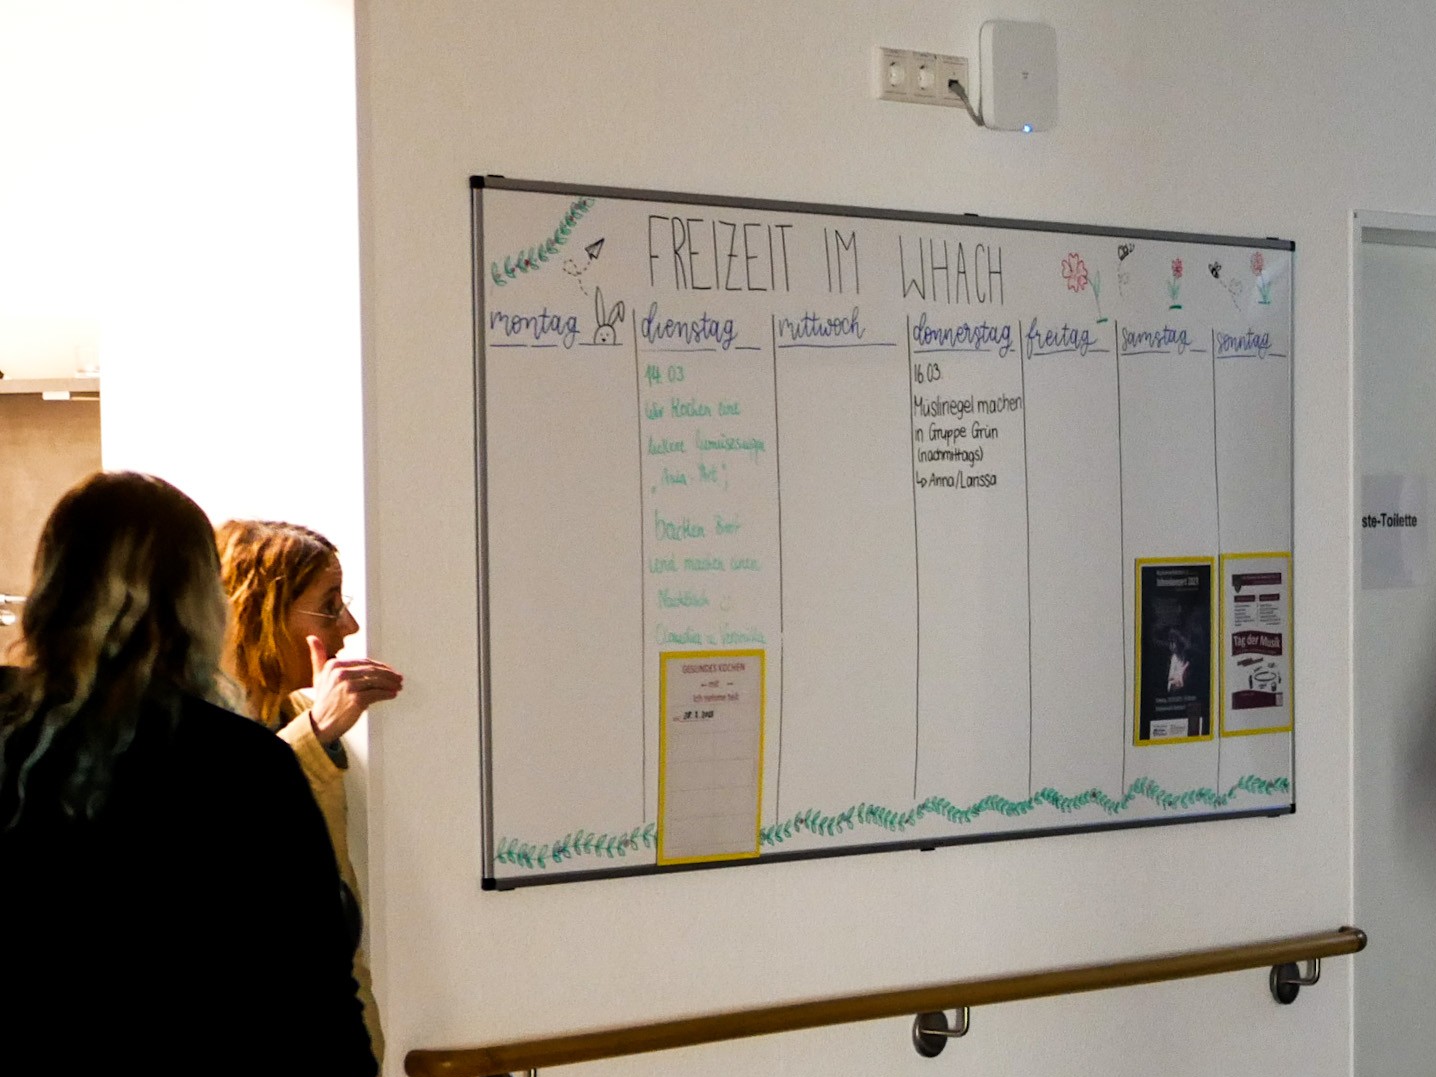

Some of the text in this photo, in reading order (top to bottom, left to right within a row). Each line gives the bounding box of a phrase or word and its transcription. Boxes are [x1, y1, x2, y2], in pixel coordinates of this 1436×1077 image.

[648, 215, 1004, 306] FREIZEIT IM WHACH
[489, 307, 580, 350] montag
[641, 301, 738, 350] dienstag
[913, 312, 1014, 359] donnerstag
[1026, 318, 1097, 359] freitag
[1121, 324, 1192, 355] samstag
[1217, 328, 1273, 359] sonntag
[977, 393, 1023, 415] machen
[928, 422, 967, 447] Gruppe
[971, 421, 998, 439] Grün
[1361, 512, 1418, 528] ste-Toilette
[1233, 635, 1246, 648] Tag
[1247, 633, 1259, 645] der
